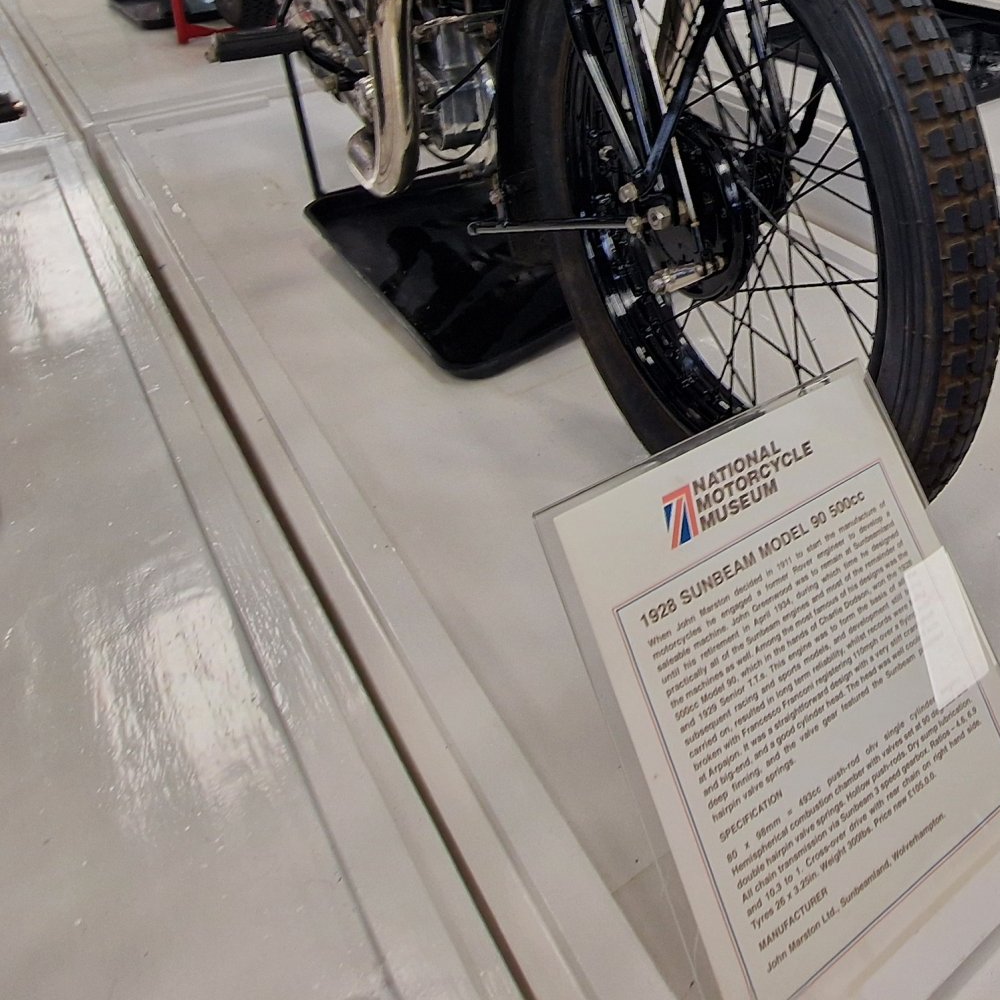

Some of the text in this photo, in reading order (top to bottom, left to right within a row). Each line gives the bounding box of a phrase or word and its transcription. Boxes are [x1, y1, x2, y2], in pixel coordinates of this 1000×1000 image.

[692, 440, 781, 495] NATIONAL
[695, 440, 814, 514] MOTORCYCLE
[699, 478, 778, 532] MUSEUM
[639, 490, 864, 627] 1928 SUNBEAM MODEL 90 500cc
[684, 707, 732, 747] subsequent
[733, 690, 759, 713] racing
[760, 677, 775, 694] and
[777, 661, 801, 683] sports
[832, 629, 846, 645] and
[847, 601, 889, 635] development
[890, 591, 903, 605] still
[688, 732, 718, 759] carried
[733, 699, 766, 728] resulted
[765, 694, 775, 705] in
[774, 681, 793, 699] long
[793, 669, 811, 686] term
[845, 630, 866, 650] whilst
[866, 613, 892, 635] records
[892, 602, 908, 617] were
[692, 745, 722, 772] broken
[722, 733, 741, 750] with
[740, 704, 781, 738] Francesco
[814, 655, 853, 687] registering
[852, 636, 879, 660] 110mph
[878, 626, 893, 641] over
[697, 771, 707, 784] at
[742, 741, 749, 752] It
[750, 731, 766, 747] was
[773, 685, 829, 731] straightforward
[829, 669, 853, 691] design
[853, 658, 869, 673] with
[874, 644, 889, 659] very
[889, 633, 903, 647] stiff
[702, 778, 719, 797] and
[753, 742, 769, 760] and
[775, 723, 796, 746] good
[795, 703, 825, 730] cylinder
[845, 678, 860, 693] The
[859, 665, 877, 683] head
[877, 656, 891, 671] was
[891, 645, 905, 660] well
[707, 789, 729, 810] deep
[765, 750, 780, 767] and
[782, 739, 796, 754] the
[798, 722, 819, 742] valve
[821, 708, 838, 728] gear
[840, 685, 869, 712] featured
[871, 676, 883, 689] the
[884, 652, 915, 679] Sunbeam
[711, 795, 741, 823] hairpin
[742, 779, 764, 800] valve
[718, 788, 783, 843] SPECIFICATION
[726, 848, 738, 863] 80
[755, 815, 781, 840] 98mm
[798, 784, 821, 807] 493cc
[826, 753, 860, 787] push-rod
[864, 739, 878, 755] ohv
[883, 719, 905, 742] single
[908, 694, 936, 721] cylinder
[730, 713, 930, 877] Hemispherical combustion chamber with valves set at 90
[736, 861, 765, 890] double
[764, 839, 794, 867] hairpin
[794, 821, 815, 843] valve
[845, 777, 870, 802] Hollow
[906, 737, 920, 753] Dry
[919, 723, 938, 743] sump
[741, 886, 753, 904] All
[753, 869, 777, 893] chain
[776, 828, 827, 874] transmission
[827, 818, 840, 832] via
[839, 790, 874, 823] Sunbeam
[873, 785, 880, 795] 3
[879, 767, 901, 791] speed
[929, 728, 951, 750] Ratios
[966, 705, 977, 719] 6.9
[746, 897, 763, 917] and
[765, 881, 782, 901] 10.3
[783, 873, 793, 885] to
[804, 828, 846, 867] Cross-over
[848, 811, 867, 832] drive
[868, 797, 884, 815] with
[885, 784, 900, 801] rear
[901, 767, 920, 788] chain
[921, 759, 931, 771] on
[932, 744, 948, 763] right
[948, 729, 965, 749] hand
[750, 906, 775, 931] Tyres
[774, 895, 786, 911] 26
[819, 844, 847, 873] Weight
[872, 807, 892, 828] Price
[892, 794, 907, 812] new
[757, 886, 828, 952] MANUFACTURER
[766, 949, 787, 973] John
[787, 919, 821, 953] Marston
